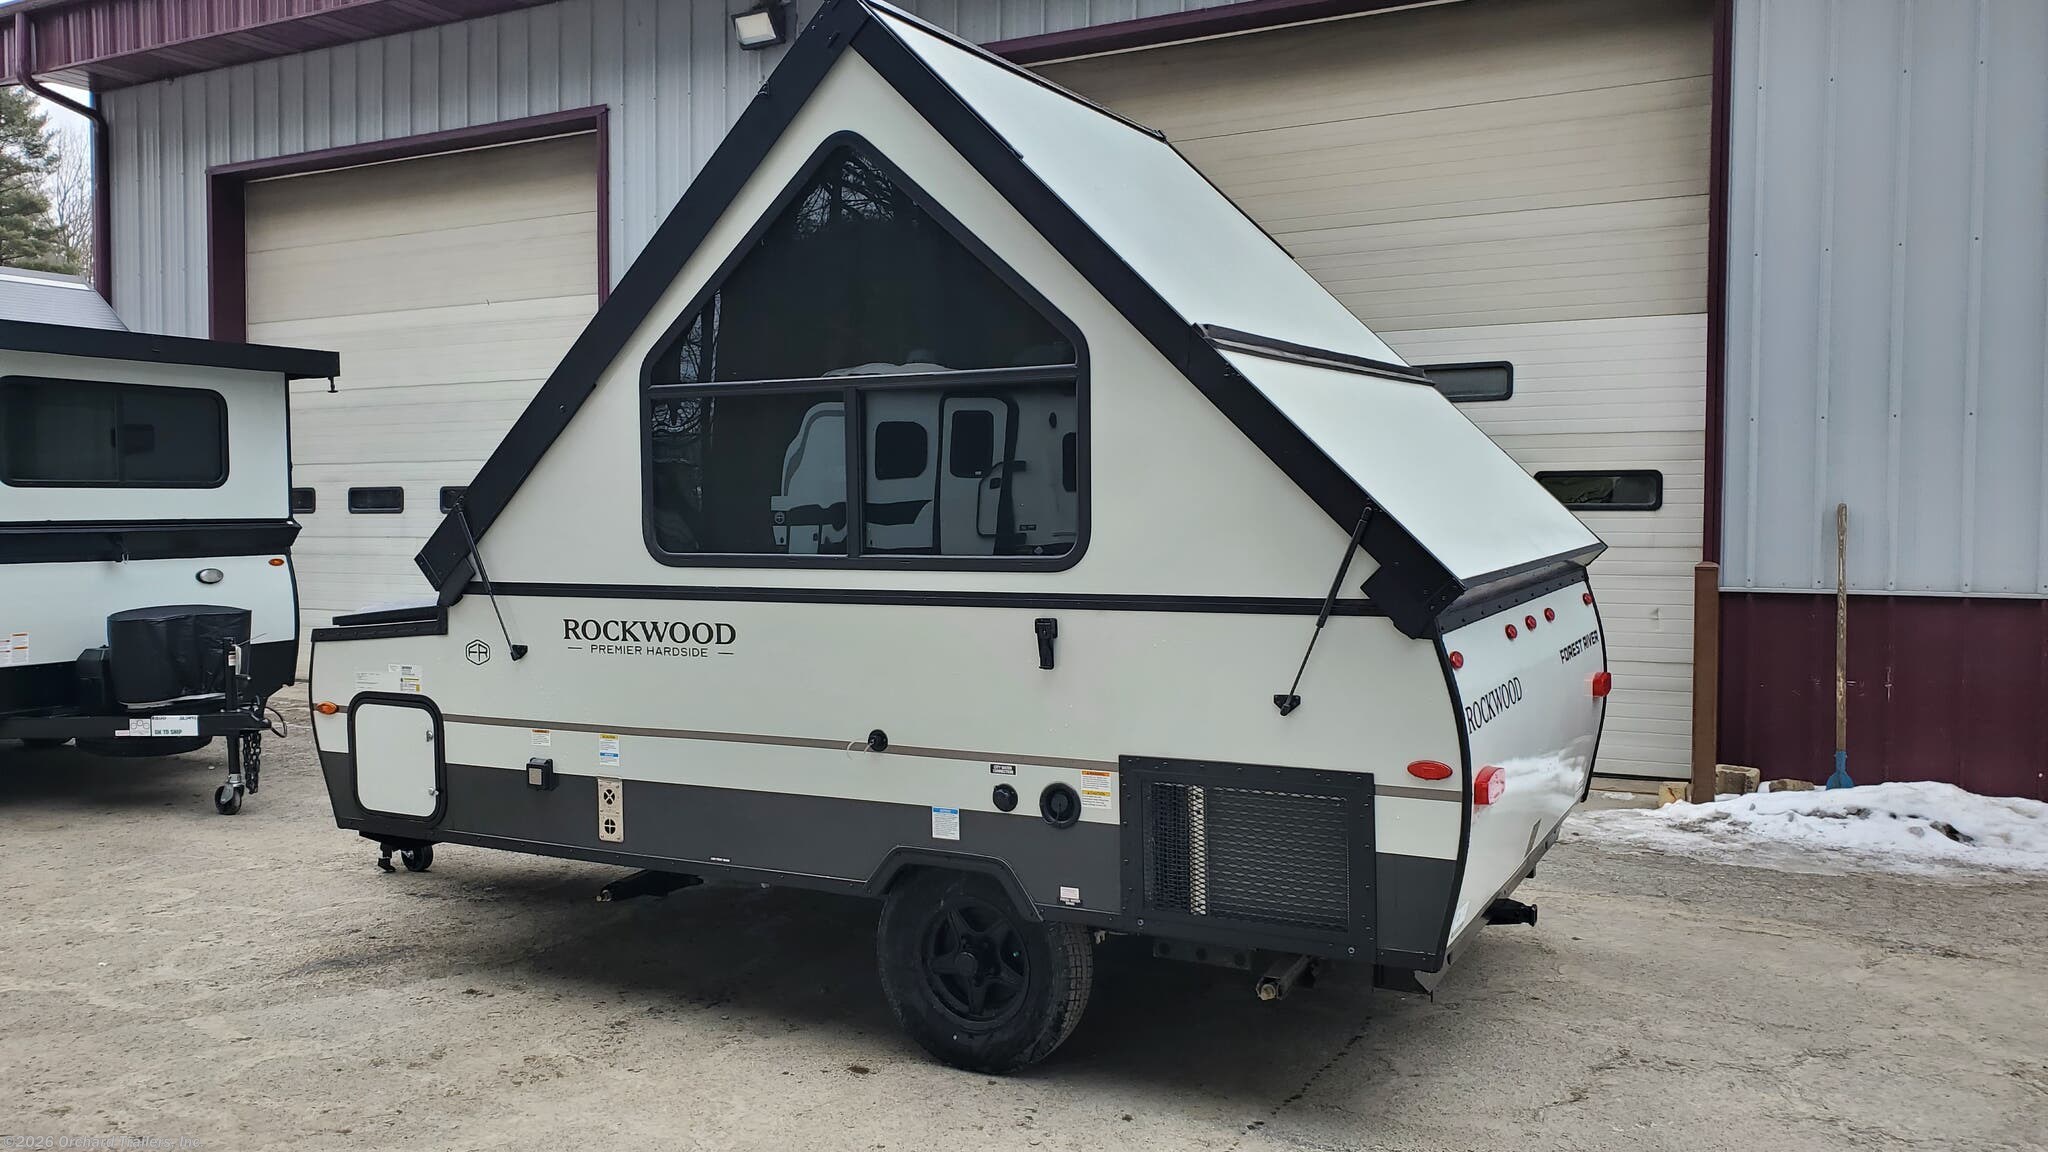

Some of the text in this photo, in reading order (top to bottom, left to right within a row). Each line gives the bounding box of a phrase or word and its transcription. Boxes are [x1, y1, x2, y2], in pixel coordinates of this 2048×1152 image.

[563, 618, 736, 645] ROCKWOOD
[590, 644, 708, 657] PREMIER HARDSIDE
[1560, 630, 1600, 664] FOREST RIVER
[1465, 676, 1522, 734] ROCKWOOD
